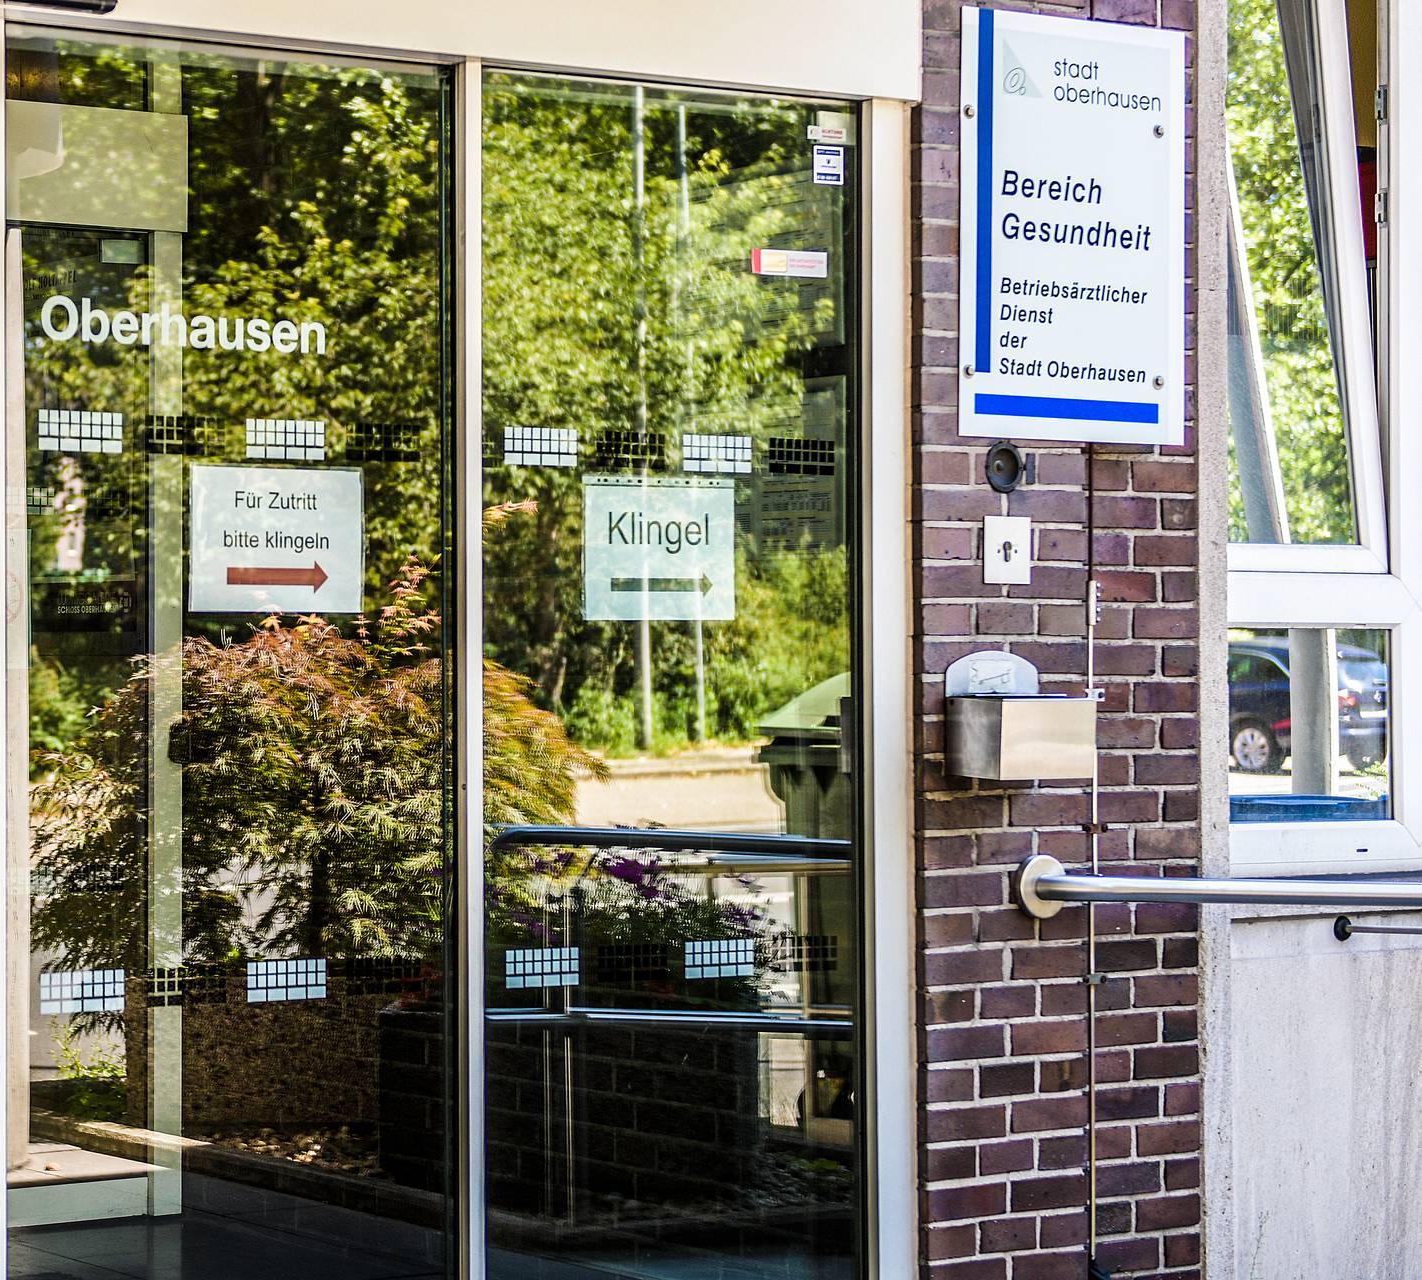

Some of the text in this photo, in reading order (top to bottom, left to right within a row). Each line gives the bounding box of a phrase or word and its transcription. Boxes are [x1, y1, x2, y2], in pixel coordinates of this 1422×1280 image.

[1053, 58, 1099, 81] stadt
[1053, 82, 1162, 112] oberhausen
[1001, 169, 1102, 205] Bereich
[1002, 212, 1151, 251] Gesundheit
[1000, 277, 1148, 304] Betriebsärztlicher
[40, 294, 327, 355] Oberhausen
[1000, 304, 1053, 324] Dienst
[999, 331, 1027, 349] der
[999, 357, 1146, 383] Stadt Oberhausen
[235, 490, 318, 511] Für Zutritt
[223, 530, 330, 554] bitte klingeln
[608, 511, 710, 555] Klingel
